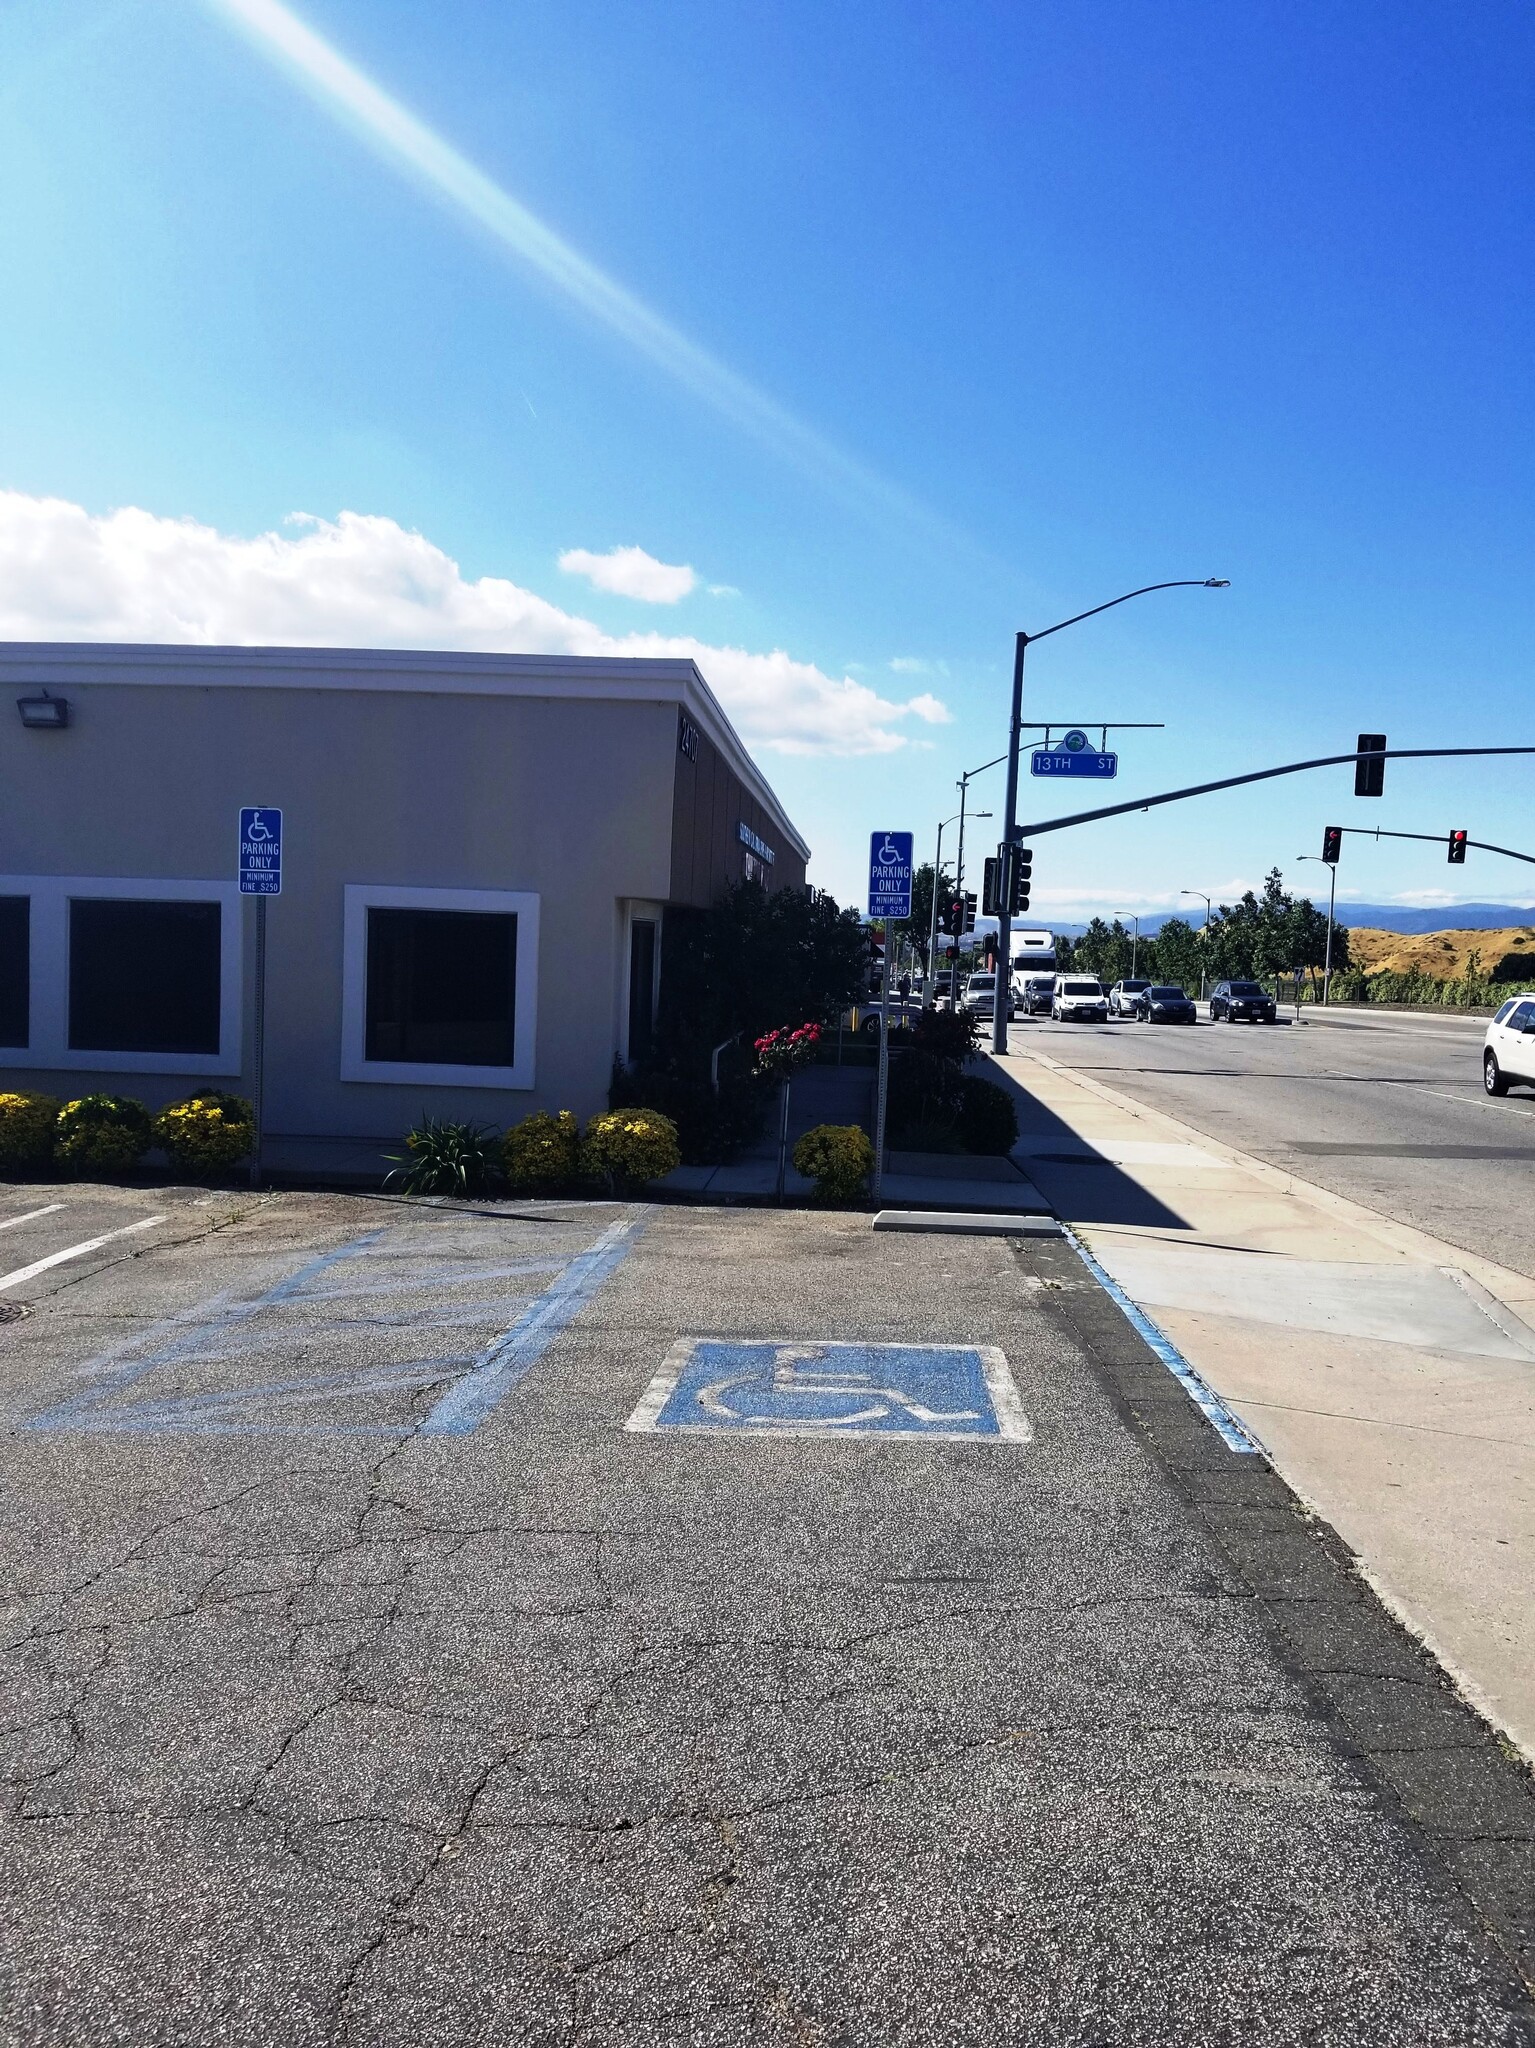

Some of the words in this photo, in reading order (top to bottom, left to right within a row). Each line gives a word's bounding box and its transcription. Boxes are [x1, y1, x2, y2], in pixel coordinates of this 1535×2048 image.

[1036, 757, 1071, 771] 13TH
[1097, 758, 1114, 769] ST
[242, 842, 279, 856] PARKING
[249, 856, 272, 869] ONLY
[246, 872, 274, 882] MINIMUM
[872, 866, 910, 879] PARKING
[242, 882, 256, 891] FINE
[260, 882, 278, 892] $250
[879, 879, 902, 892] ONLY
[876, 895, 903, 905] MINIMUM
[871, 905, 885, 915] FINE
[889, 905, 908, 915] $250
